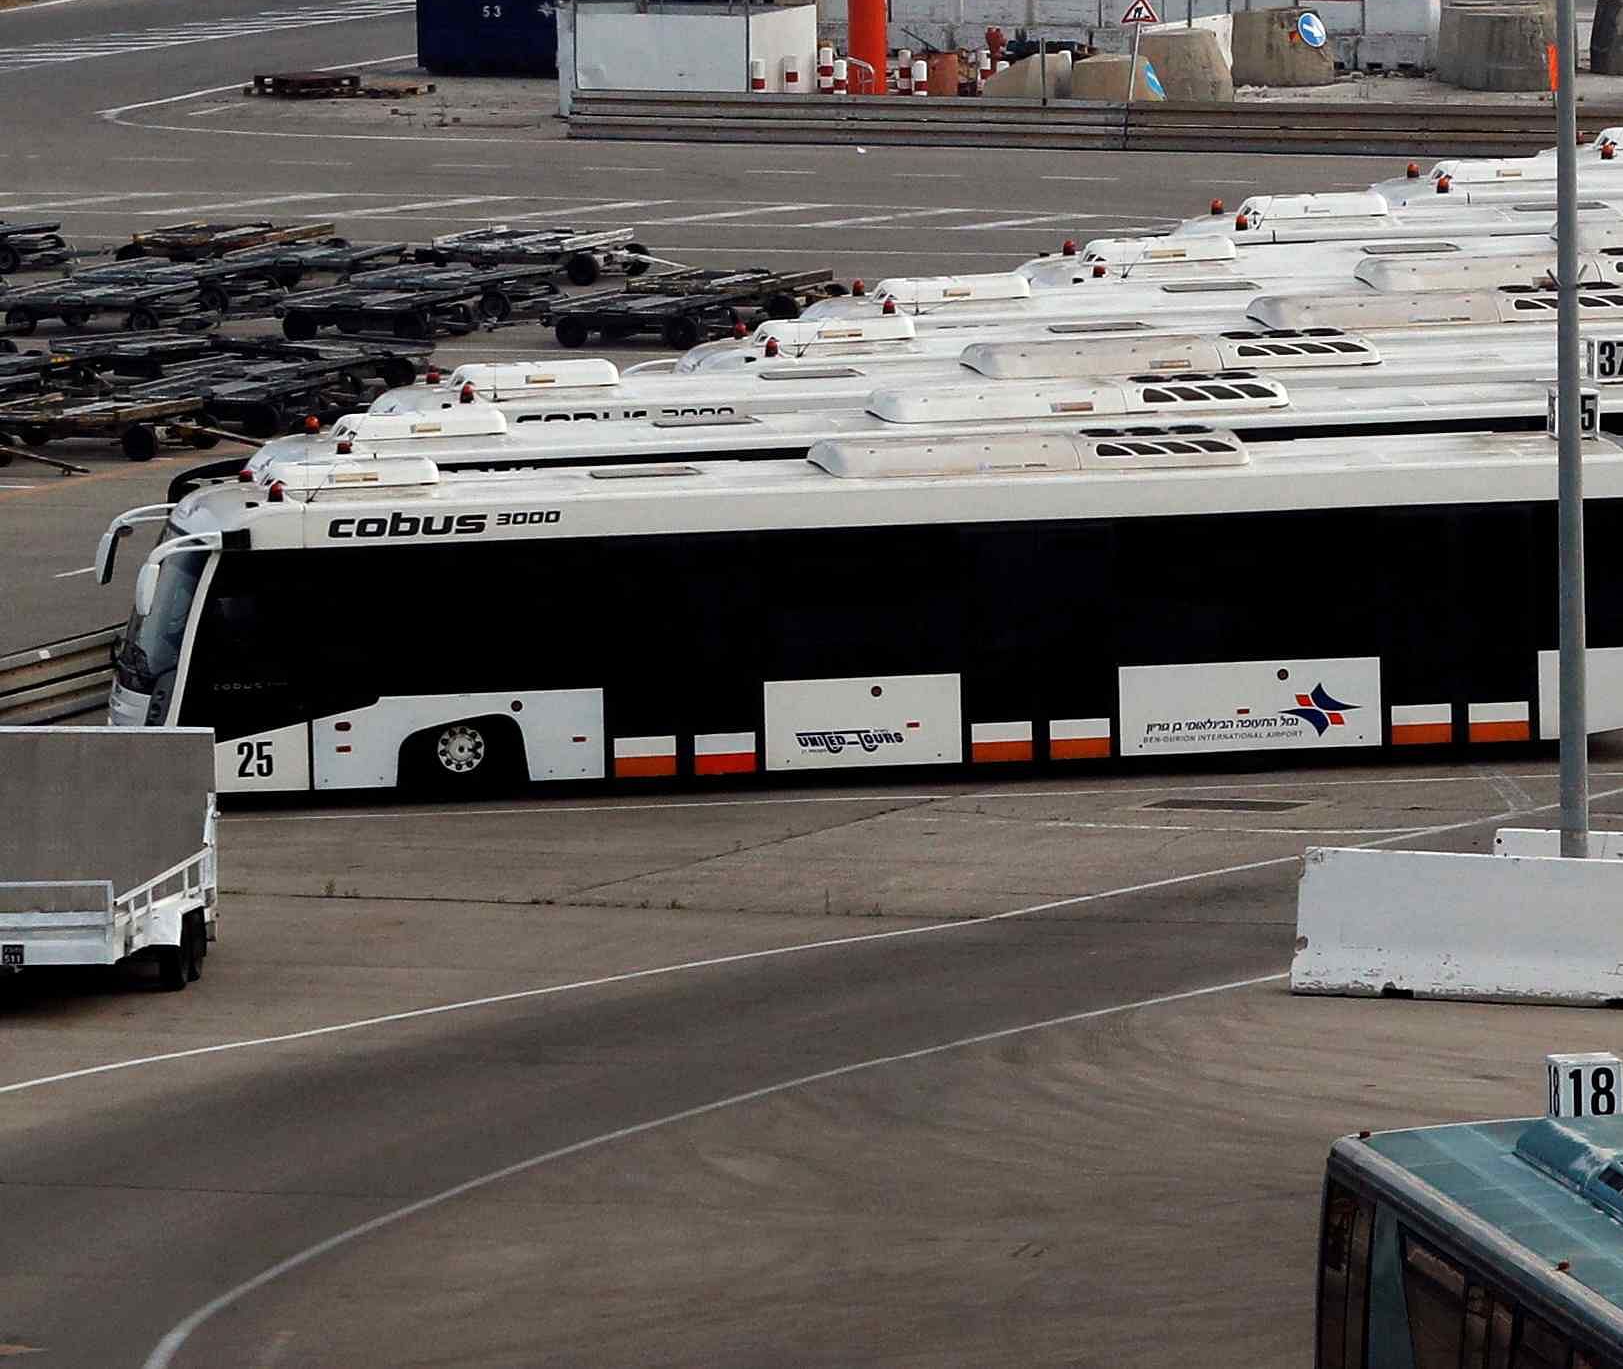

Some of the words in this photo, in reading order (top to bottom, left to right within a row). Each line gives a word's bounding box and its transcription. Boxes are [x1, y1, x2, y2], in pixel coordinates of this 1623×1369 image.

[328, 511, 488, 538] cobus
[496, 510, 561, 526] 3000
[1197, 731, 1263, 742] INTERNATIONAL
[1265, 729, 1304, 739] AIRPORT
[1237, 718, 1278, 731] התעופה
[1279, 715, 1300, 730] נמל
[237, 741, 274, 778] 25
[1548, 1064, 1561, 1118] 18
[1568, 1067, 1617, 1117] 18
